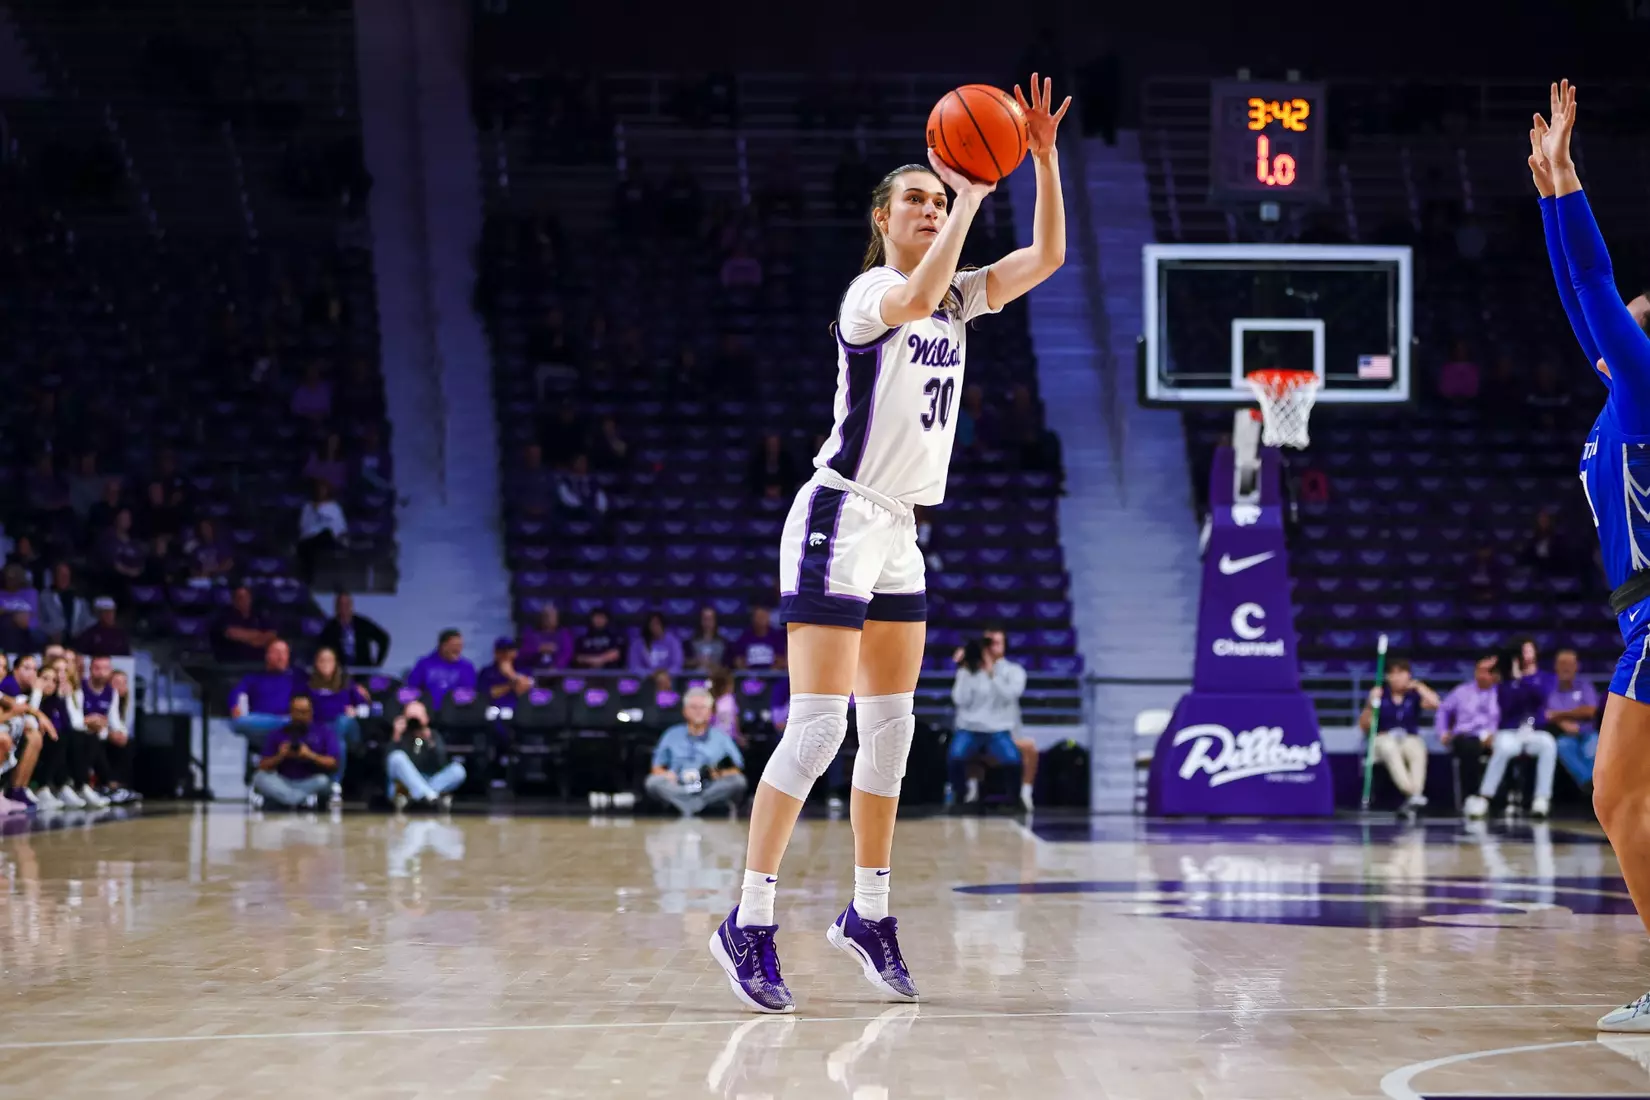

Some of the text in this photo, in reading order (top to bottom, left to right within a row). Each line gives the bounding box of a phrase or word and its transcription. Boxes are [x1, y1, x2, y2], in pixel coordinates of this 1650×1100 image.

[1248, 97, 1310, 131] 3:42
[1257, 134, 1296, 186] 1.0
[919, 376, 955, 432] 30
[1172, 723, 1323, 781] Dillons
